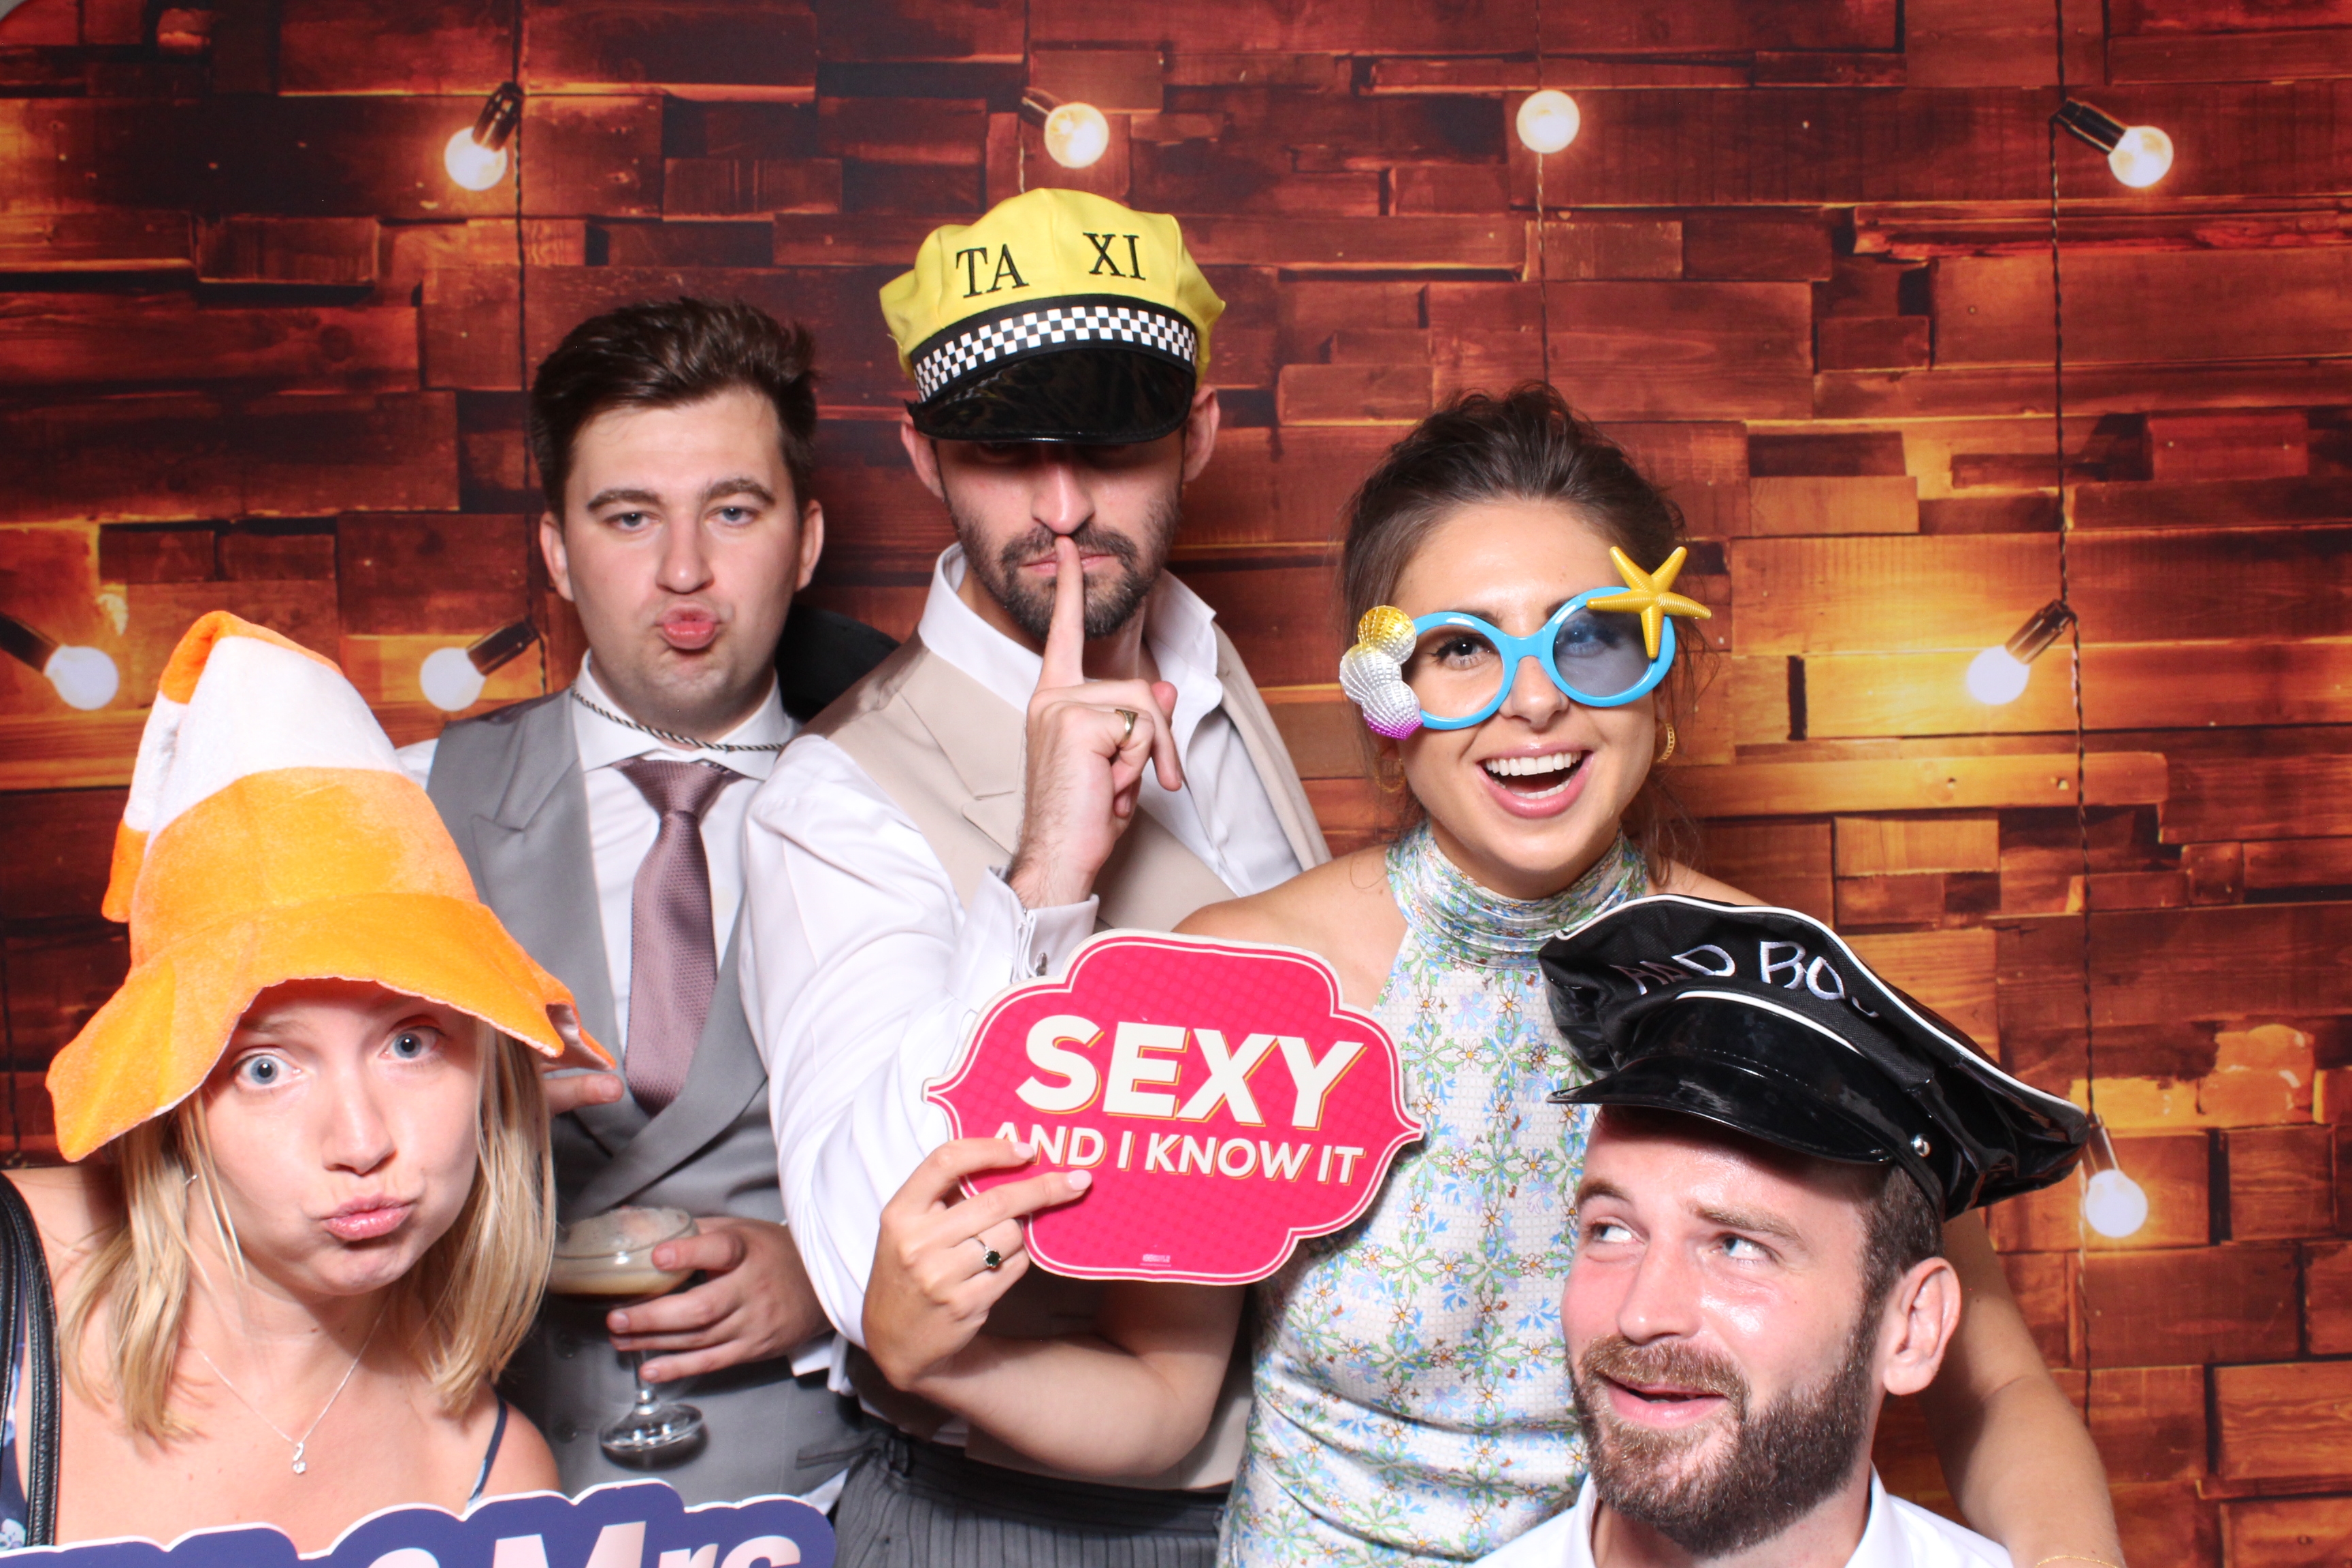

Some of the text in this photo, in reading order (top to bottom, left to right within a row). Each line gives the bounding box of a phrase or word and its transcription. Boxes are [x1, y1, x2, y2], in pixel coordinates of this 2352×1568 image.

[1759, 940, 1880, 1018] BO
[1015, 1014, 1368, 1131] SEXY
[1117, 1130, 1136, 1172] I
[1145, 1132, 1314, 1183] KNOW
[1317, 1145, 1367, 1186] IT
